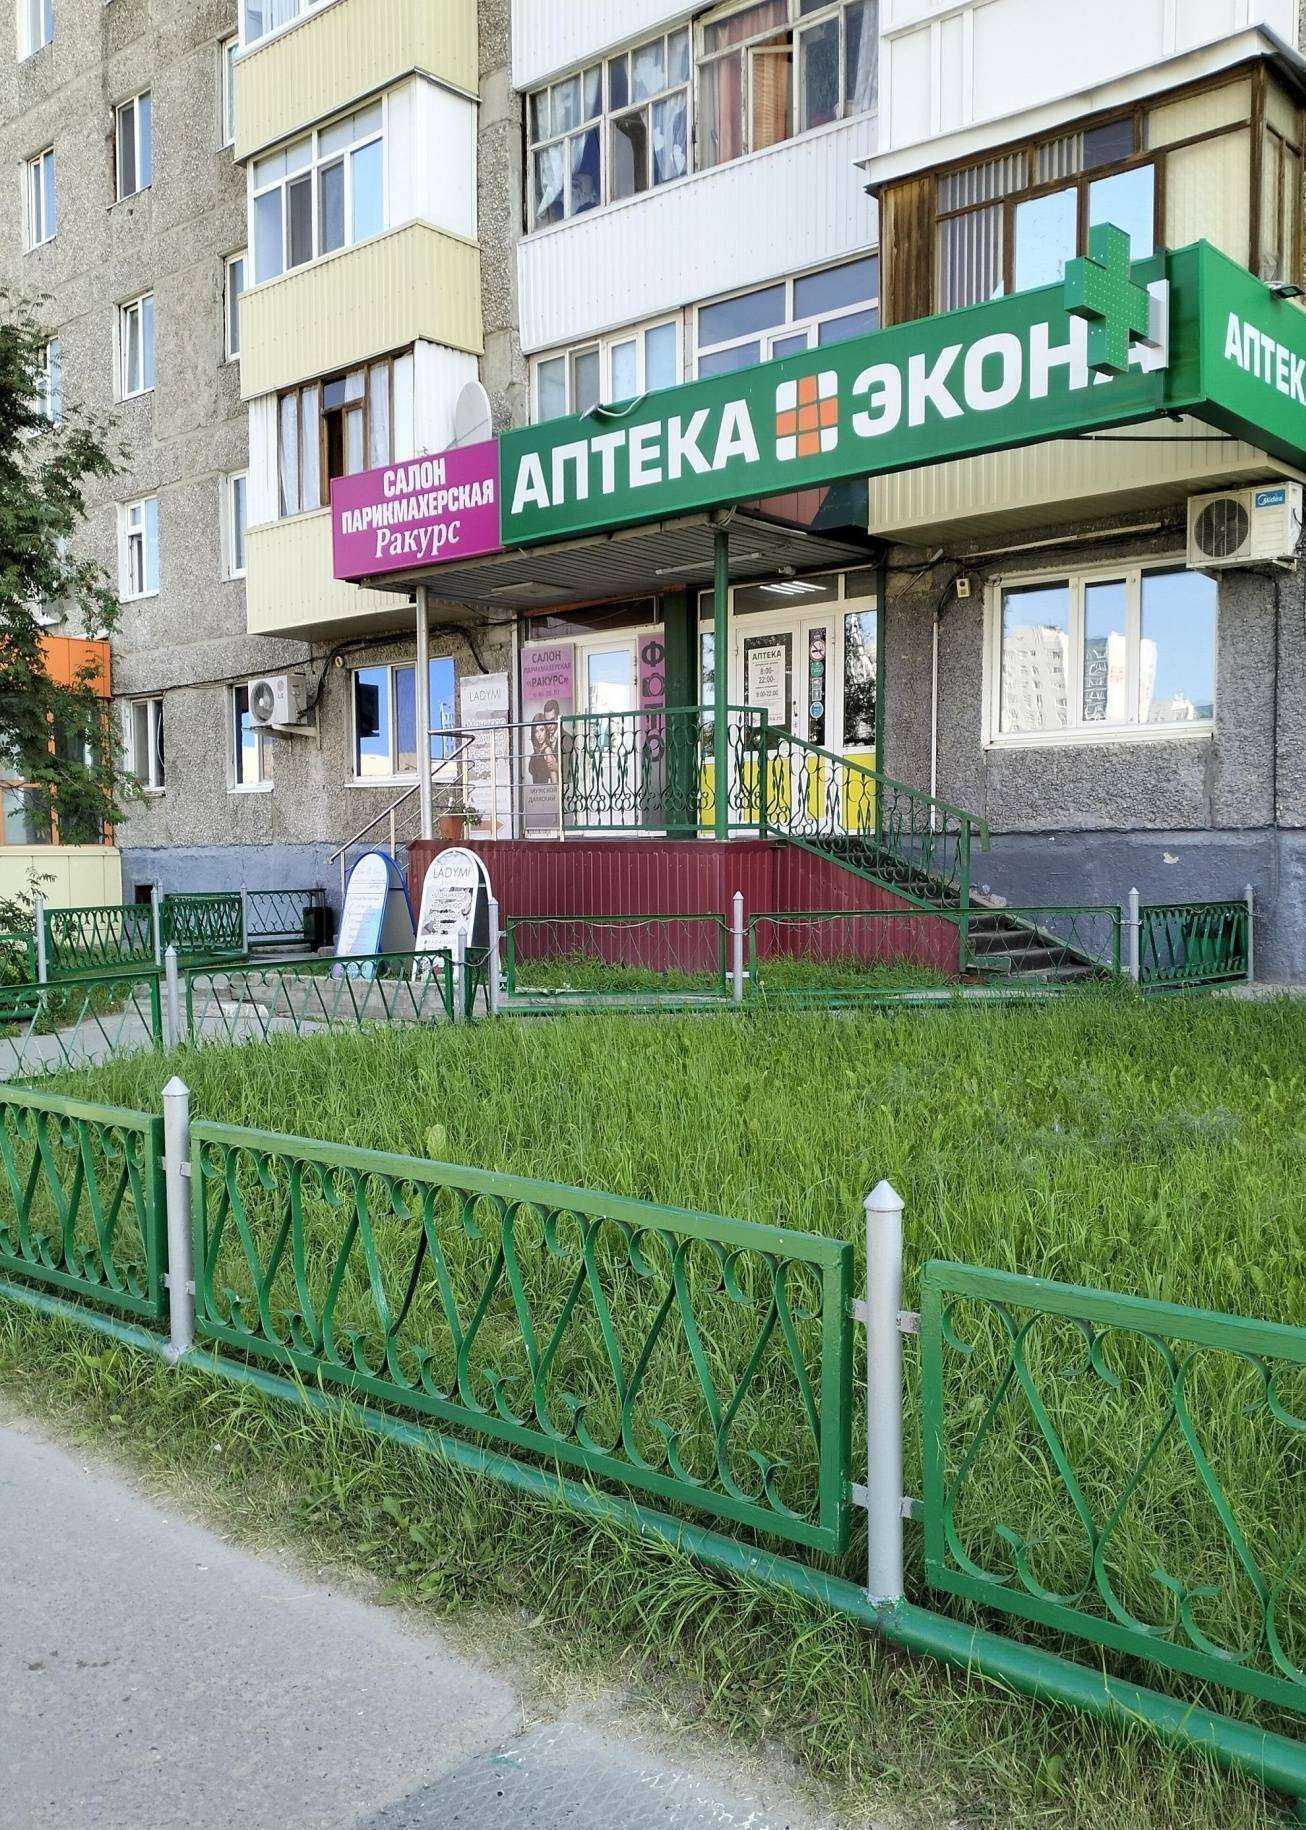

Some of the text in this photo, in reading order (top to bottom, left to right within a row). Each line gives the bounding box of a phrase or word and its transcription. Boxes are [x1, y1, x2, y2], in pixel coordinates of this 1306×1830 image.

[511, 399, 760, 515] АПТЕКА
[383, 458, 446, 498] САЛОН
[341, 479, 494, 535] ПАРИКМАХЕРСКАЯ
[375, 520, 461, 559] Ракурс
[532, 650, 561, 663] САЛОН
[752, 650, 782, 660] АПТЕКА
